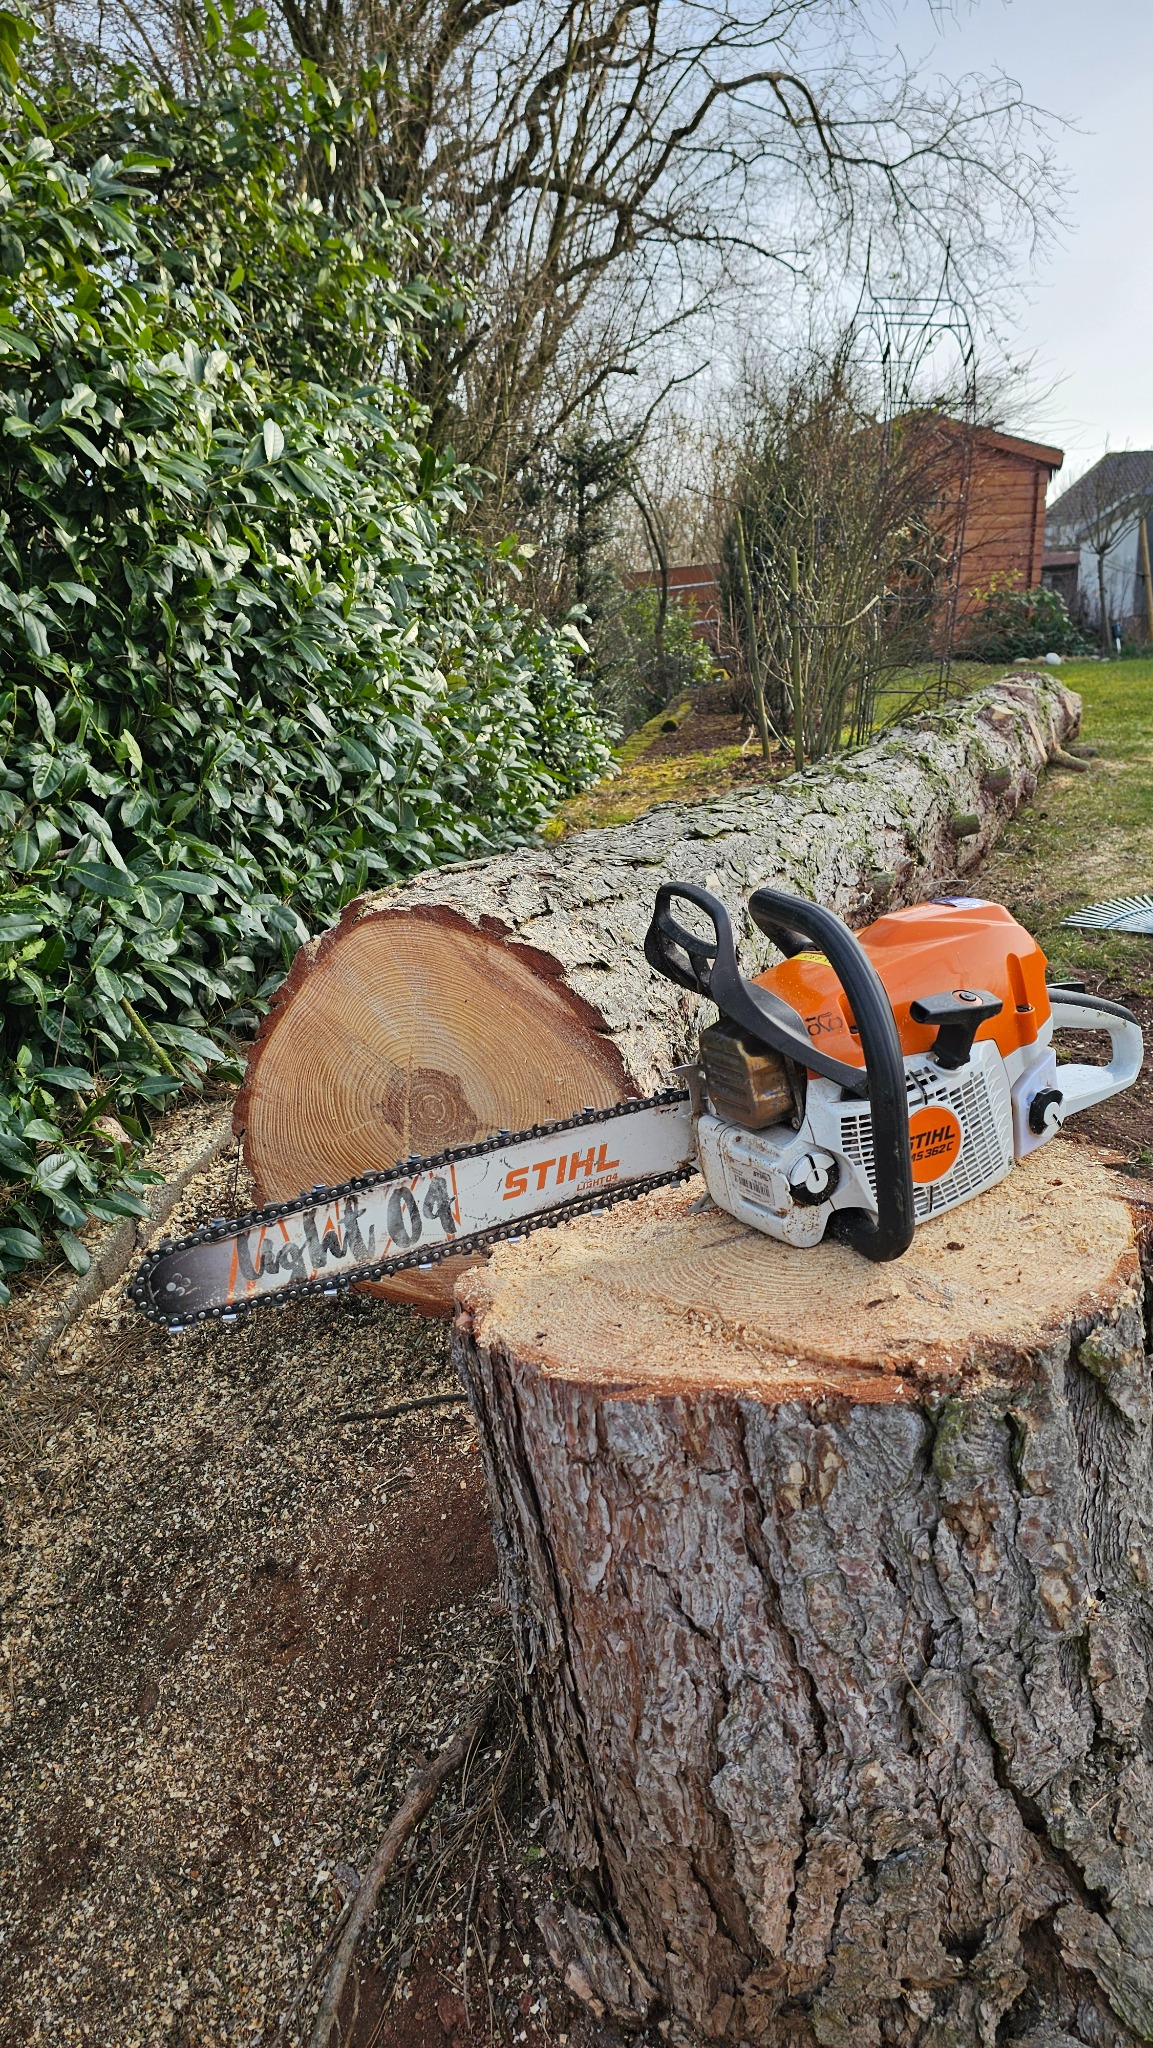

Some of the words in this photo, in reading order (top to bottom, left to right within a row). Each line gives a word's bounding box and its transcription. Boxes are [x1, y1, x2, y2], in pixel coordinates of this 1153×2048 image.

[503, 1143, 620, 1201] STIHL
[576, 1177, 605, 1192] LIGHT
[605, 1172, 618, 1183] 04
